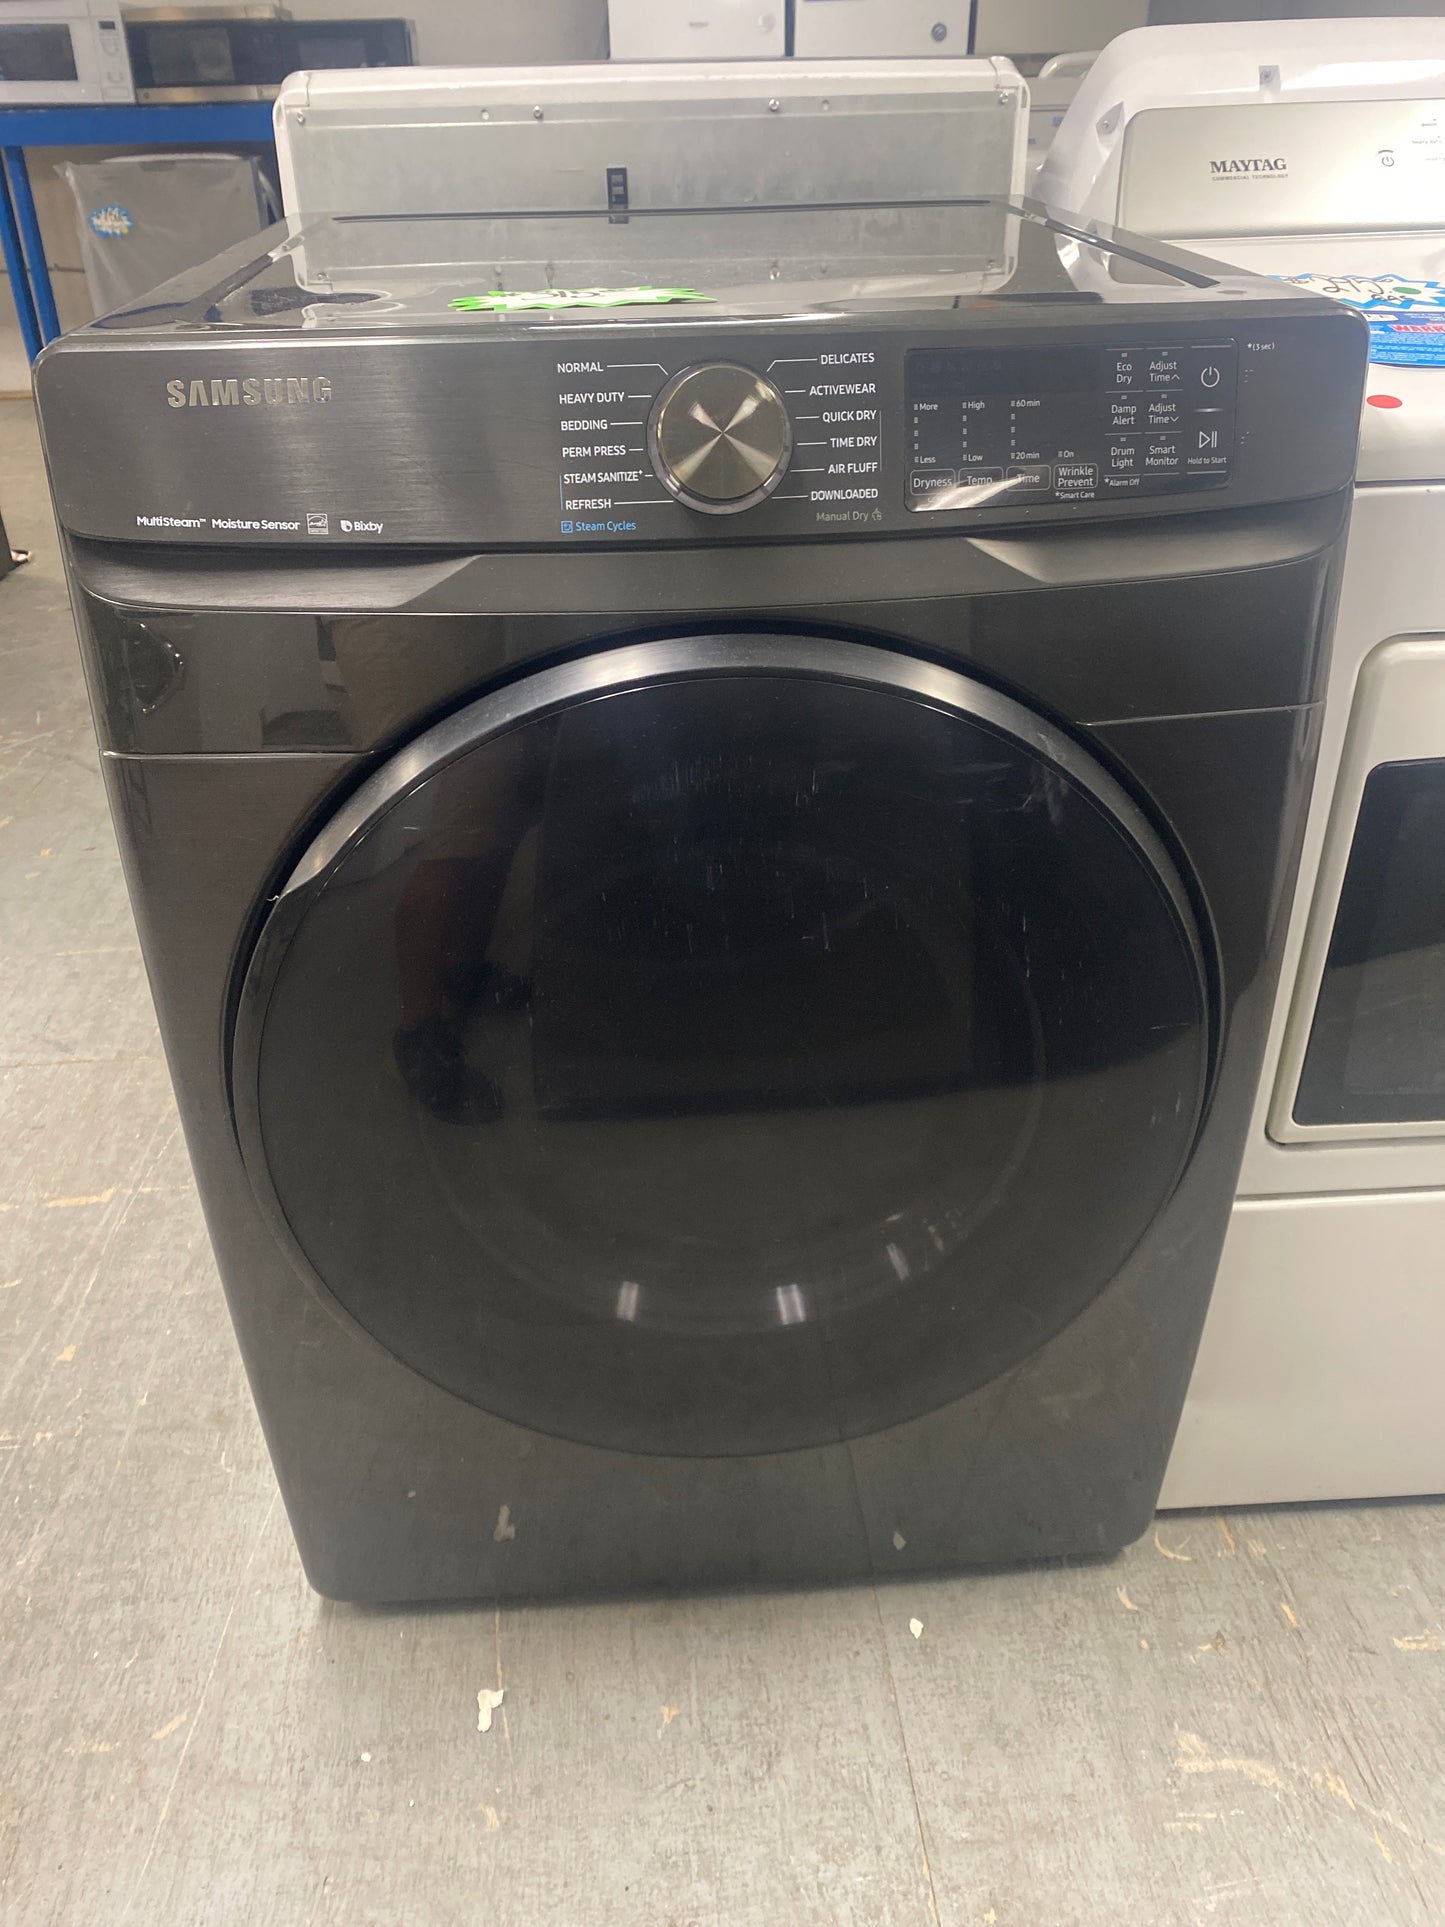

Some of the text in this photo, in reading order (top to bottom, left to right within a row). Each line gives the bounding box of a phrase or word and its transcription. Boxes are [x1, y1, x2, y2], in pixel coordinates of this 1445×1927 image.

[1209, 158, 1287, 173] MAYTAG
[820, 353, 875, 365] DELICATES
[557, 362, 604, 374] NORMAL
[1116, 362, 1133, 371] Eco
[1149, 361, 1177, 371] Adjust
[1116, 374, 1133, 384] Dry
[1150, 373, 1171, 382] Time
[166, 377, 332, 408] SAMSUNG
[809, 383, 877, 396] ACTIVEWEAR
[559, 392, 625, 404] HEAVY DUTY
[1016, 399, 1041, 408] 60 min
[919, 403, 938, 411] More
[967, 401, 986, 410] High
[1111, 405, 1137, 415] Damp
[1148, 403, 1177, 414] Adjust
[822, 410, 877, 423] QUICK DRY
[1112, 416, 1136, 426] Alert
[1149, 415, 1170, 424] Time
[560, 420, 608, 431] BEDDING
[830, 436, 878, 449] TIME DRY
[562, 445, 627, 458] PERM PRESS
[1016, 451, 1041, 460] 20 min
[1063, 450, 1075, 458] On
[1110, 447, 1135, 456] Drum
[1149, 445, 1177, 455] Smart
[919, 455, 937, 464] Less
[968, 454, 984, 463] Low
[1111, 458, 1134, 469] Light
[1145, 456, 1179, 467] Monitor
[1187, 457, 1202, 465] Hold
[1211, 456, 1227, 464] Start
[828, 463, 878, 475] AIR FLUFF
[1058, 465, 1094, 477] Wrinkle
[563, 473, 596, 484] STEAM
[913, 477, 953, 489] Dryness
[966, 475, 993, 485] Temp
[1017, 473, 1041, 484] Time
[1057, 477, 1094, 488] Prevent
[1129, 478, 1140, 486] Off
[811, 488, 879, 500] DOWNLOADED
[565, 499, 612, 510] REFRESH
[816, 511, 869, 522] Manual Dry
[211, 518, 260, 530] Moisture
[261, 519, 301, 530] Sensor
[354, 520, 384, 534] Bixby
[575, 521, 637, 532] Steam Cycles
